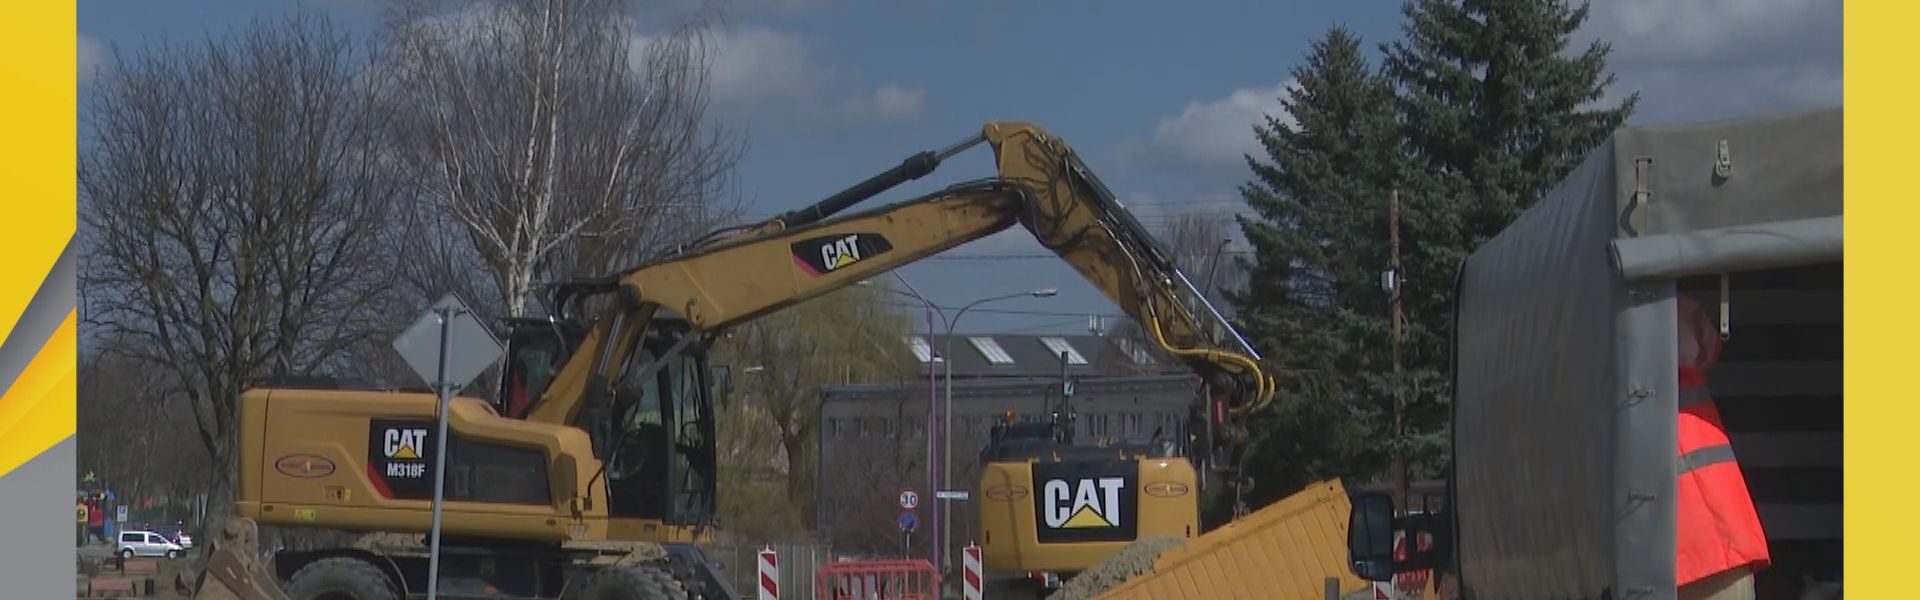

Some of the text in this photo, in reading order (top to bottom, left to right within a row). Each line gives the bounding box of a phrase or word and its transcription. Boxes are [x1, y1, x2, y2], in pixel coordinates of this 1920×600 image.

[821, 235, 860, 270] CAT
[384, 429, 427, 458] CAT
[387, 463, 425, 478] M318F
[902, 495, 917, 505] 30
[1044, 477, 1124, 528] CAT
